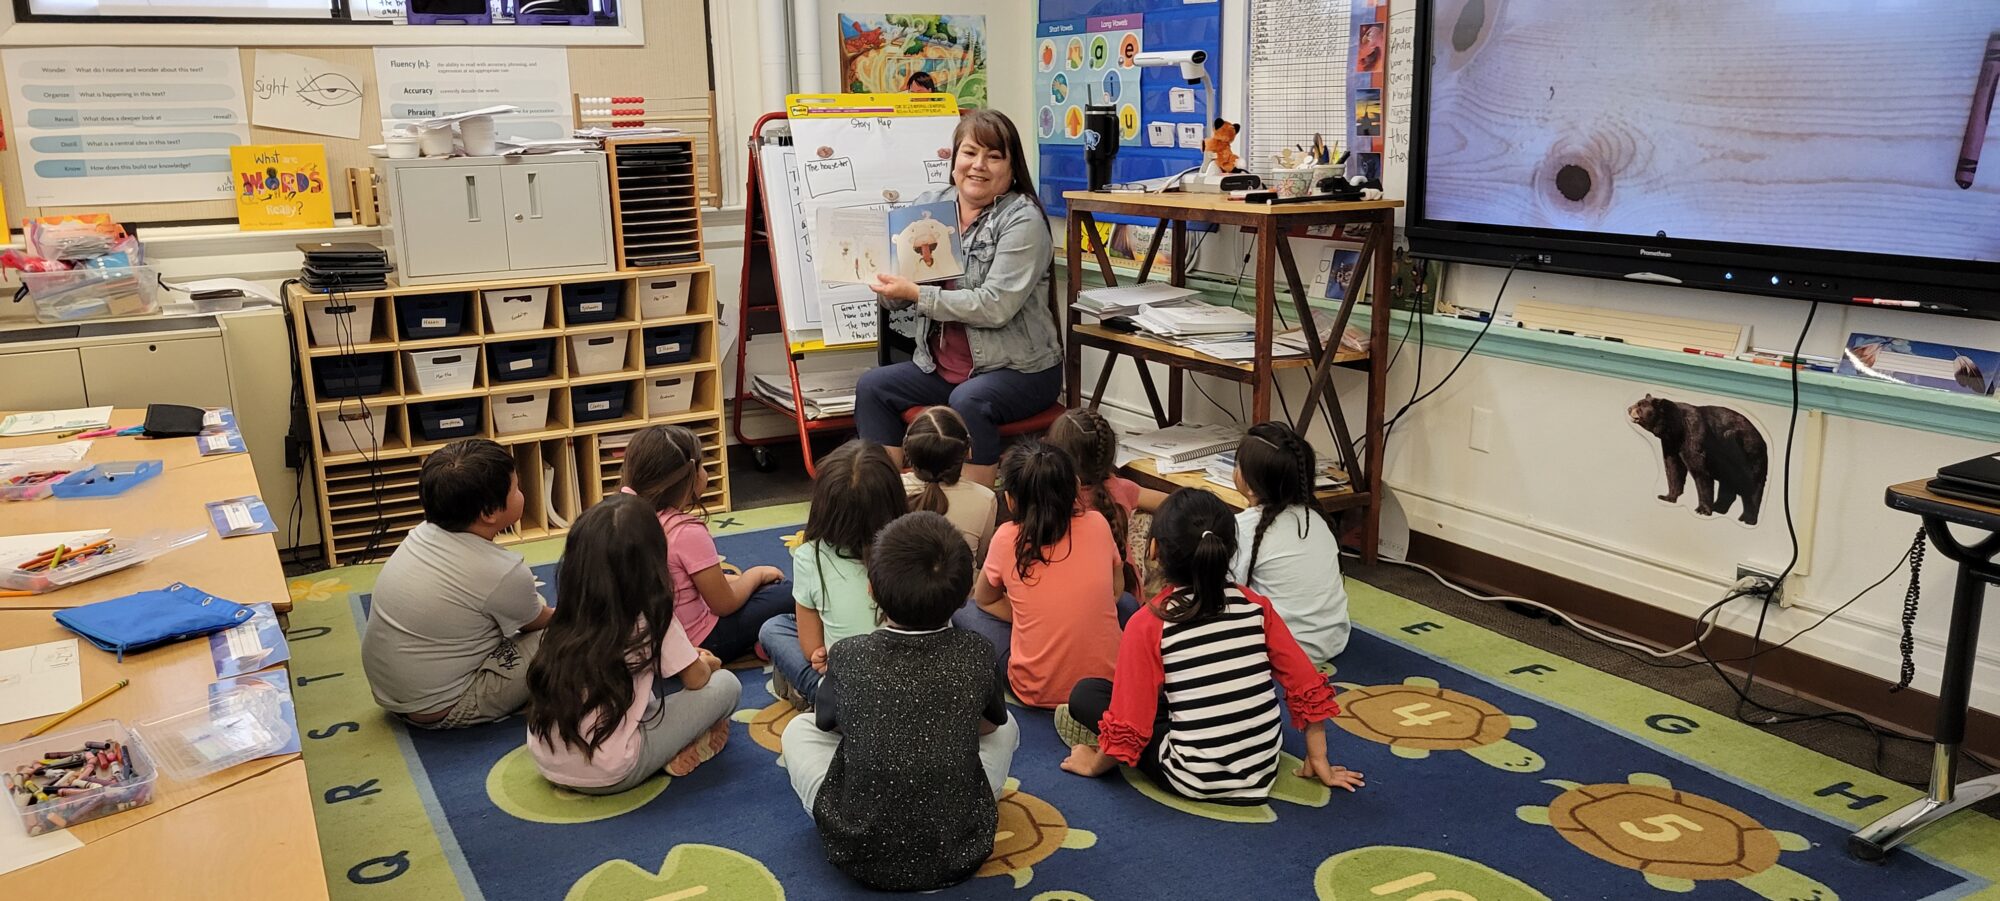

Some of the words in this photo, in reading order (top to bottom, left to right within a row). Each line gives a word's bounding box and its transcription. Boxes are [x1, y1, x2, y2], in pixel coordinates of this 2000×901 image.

[1060, 24, 1073, 32] Vowels
[1112, 19, 1128, 27] Vowels
[1094, 45, 1103, 60] a
[1125, 43, 1134, 58] e
[390, 60, 416, 69] Fluency
[404, 87, 433, 95] Accuracy
[1110, 76, 1114, 97] i
[407, 108, 436, 117] Phrasing
[851, 117, 871, 130] Story
[877, 117, 892, 129] Map
[1125, 114, 1132, 129] u
[254, 149, 280, 164] What
[282, 156, 298, 164] are
[158, 162, 191, 170] knowledge?
[806, 163, 819, 172] The
[241, 171, 324, 195] WORDS
[266, 200, 304, 218] Really?
[1640, 248, 1672, 257] Promethean
[845, 321, 858, 330] The
[712, 517, 745, 529] X
[287, 626, 332, 642] U
[1401, 621, 1444, 635] E
[1509, 664, 1557, 675] F
[297, 672, 344, 687] T
[1392, 702, 1452, 727] 4
[307, 721, 360, 740] S
[1644, 714, 1700, 734] G
[324, 778, 383, 804] R
[1813, 781, 1888, 810] H
[1618, 813, 1704, 842] 5
[347, 850, 411, 884] Q
